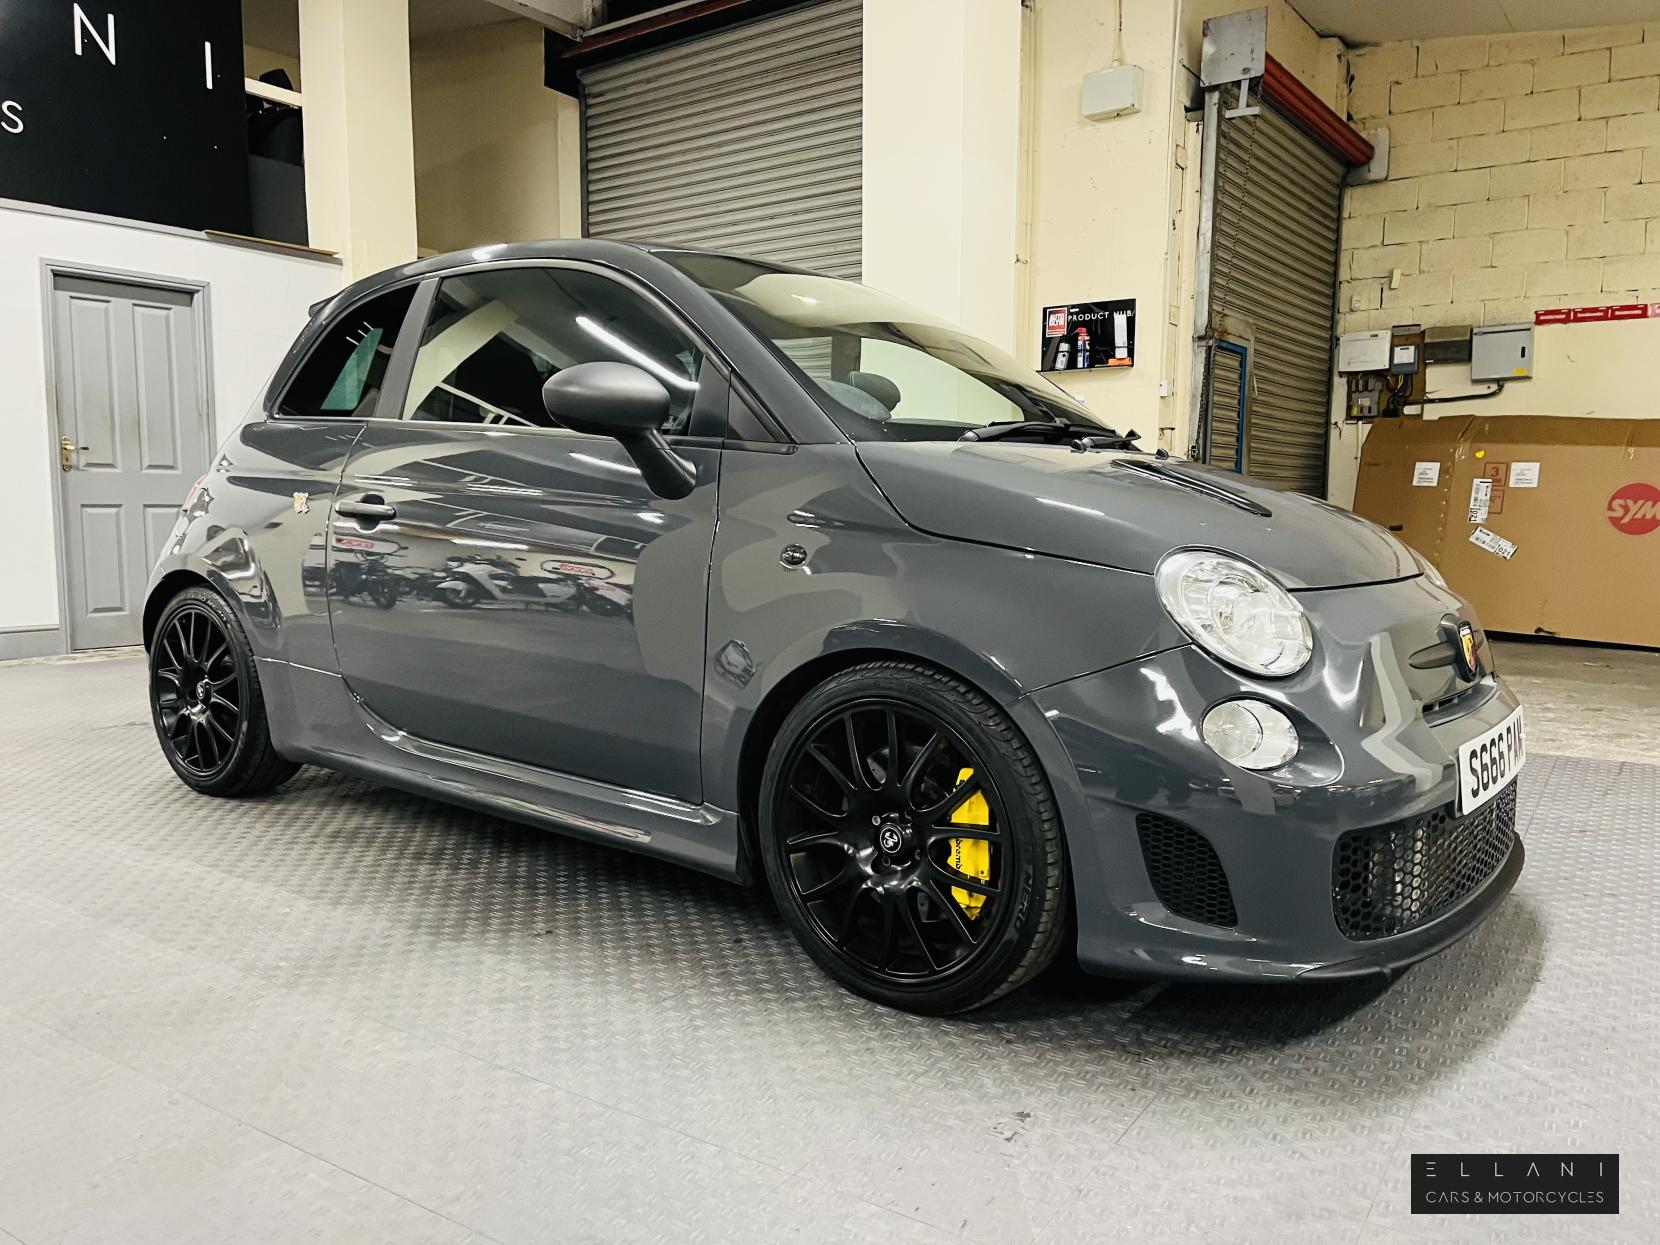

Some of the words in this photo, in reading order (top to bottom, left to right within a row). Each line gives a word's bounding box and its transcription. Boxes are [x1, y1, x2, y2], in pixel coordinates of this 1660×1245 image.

[1068, 312, 1109, 322] PRODUCT
[1607, 498, 1660, 524] SYM
[1469, 732, 1506, 799] S666
[955, 838, 963, 870] bremb
